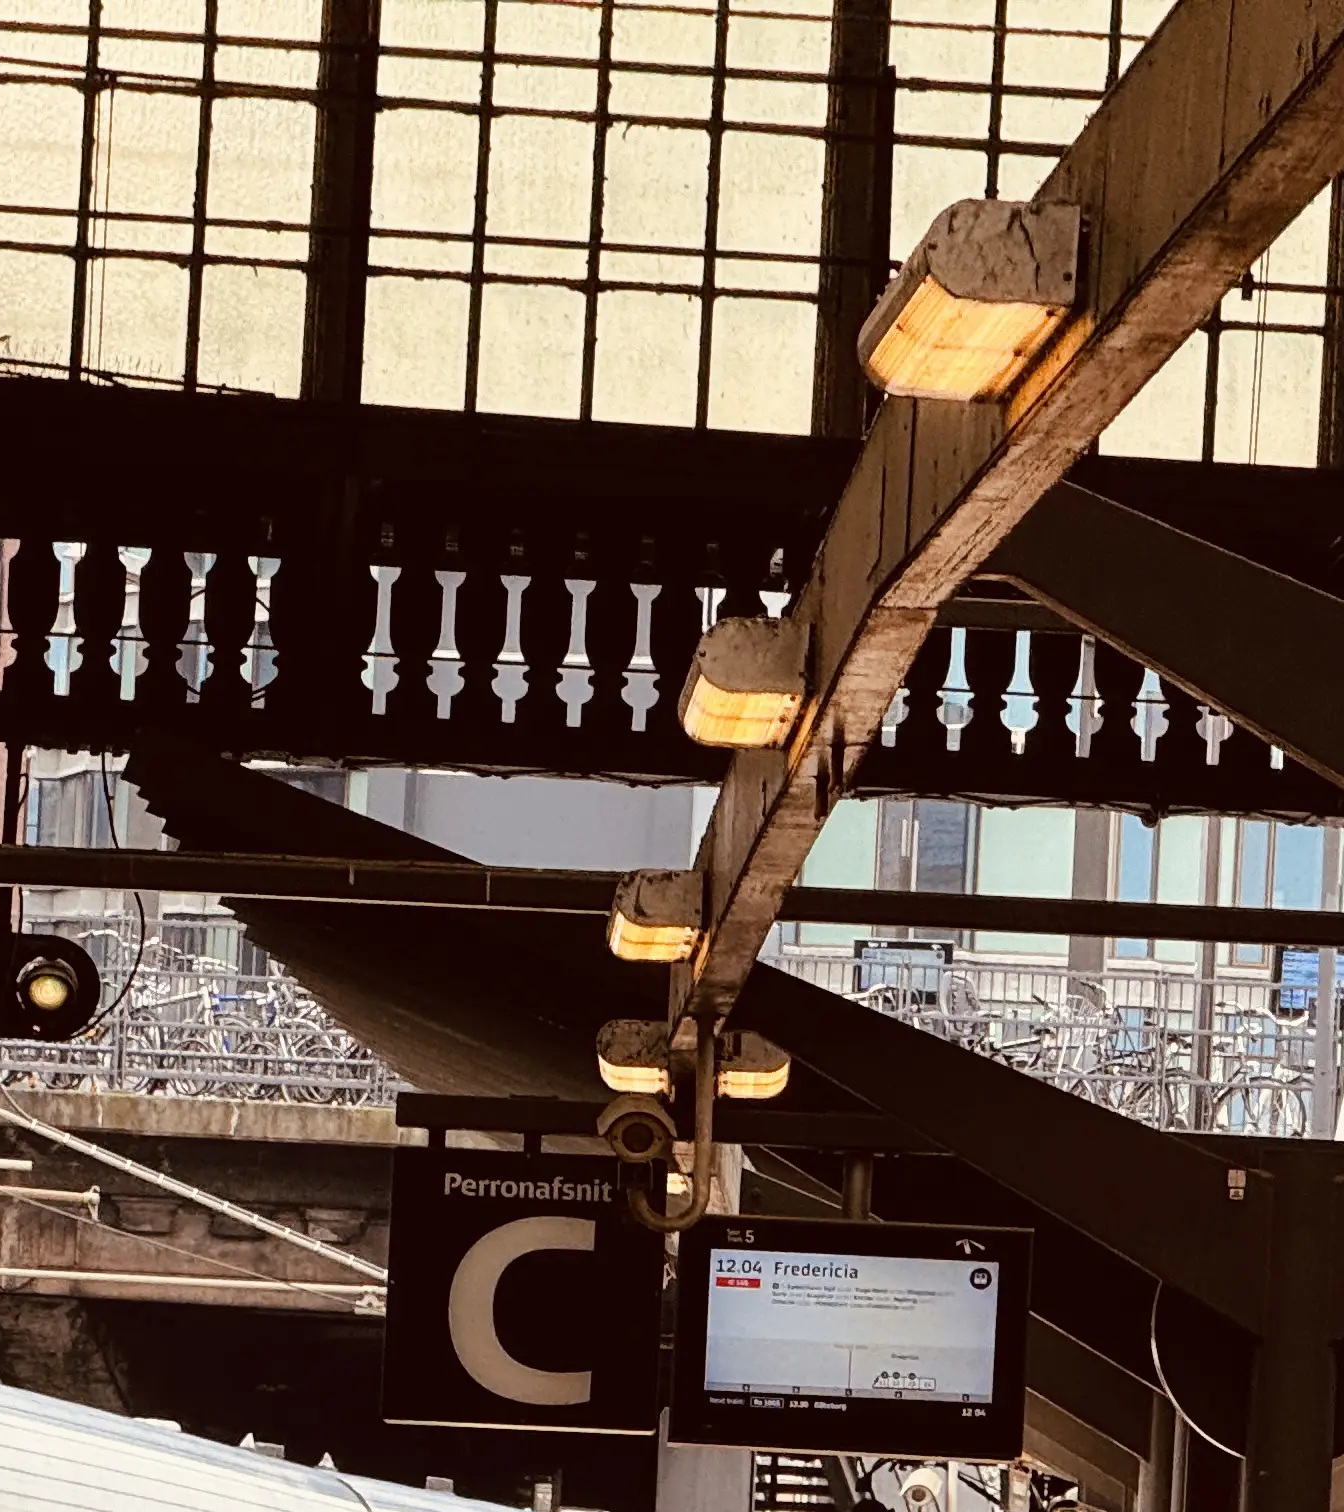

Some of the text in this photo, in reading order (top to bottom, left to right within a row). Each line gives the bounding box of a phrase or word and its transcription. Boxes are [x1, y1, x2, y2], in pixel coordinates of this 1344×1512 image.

[444, 1172, 613, 1203] Perronafsnit
[744, 1229, 755, 1244] 5
[715, 1259, 860, 1280] 12.04 Fredericia
[448, 1215, 597, 1406] C
